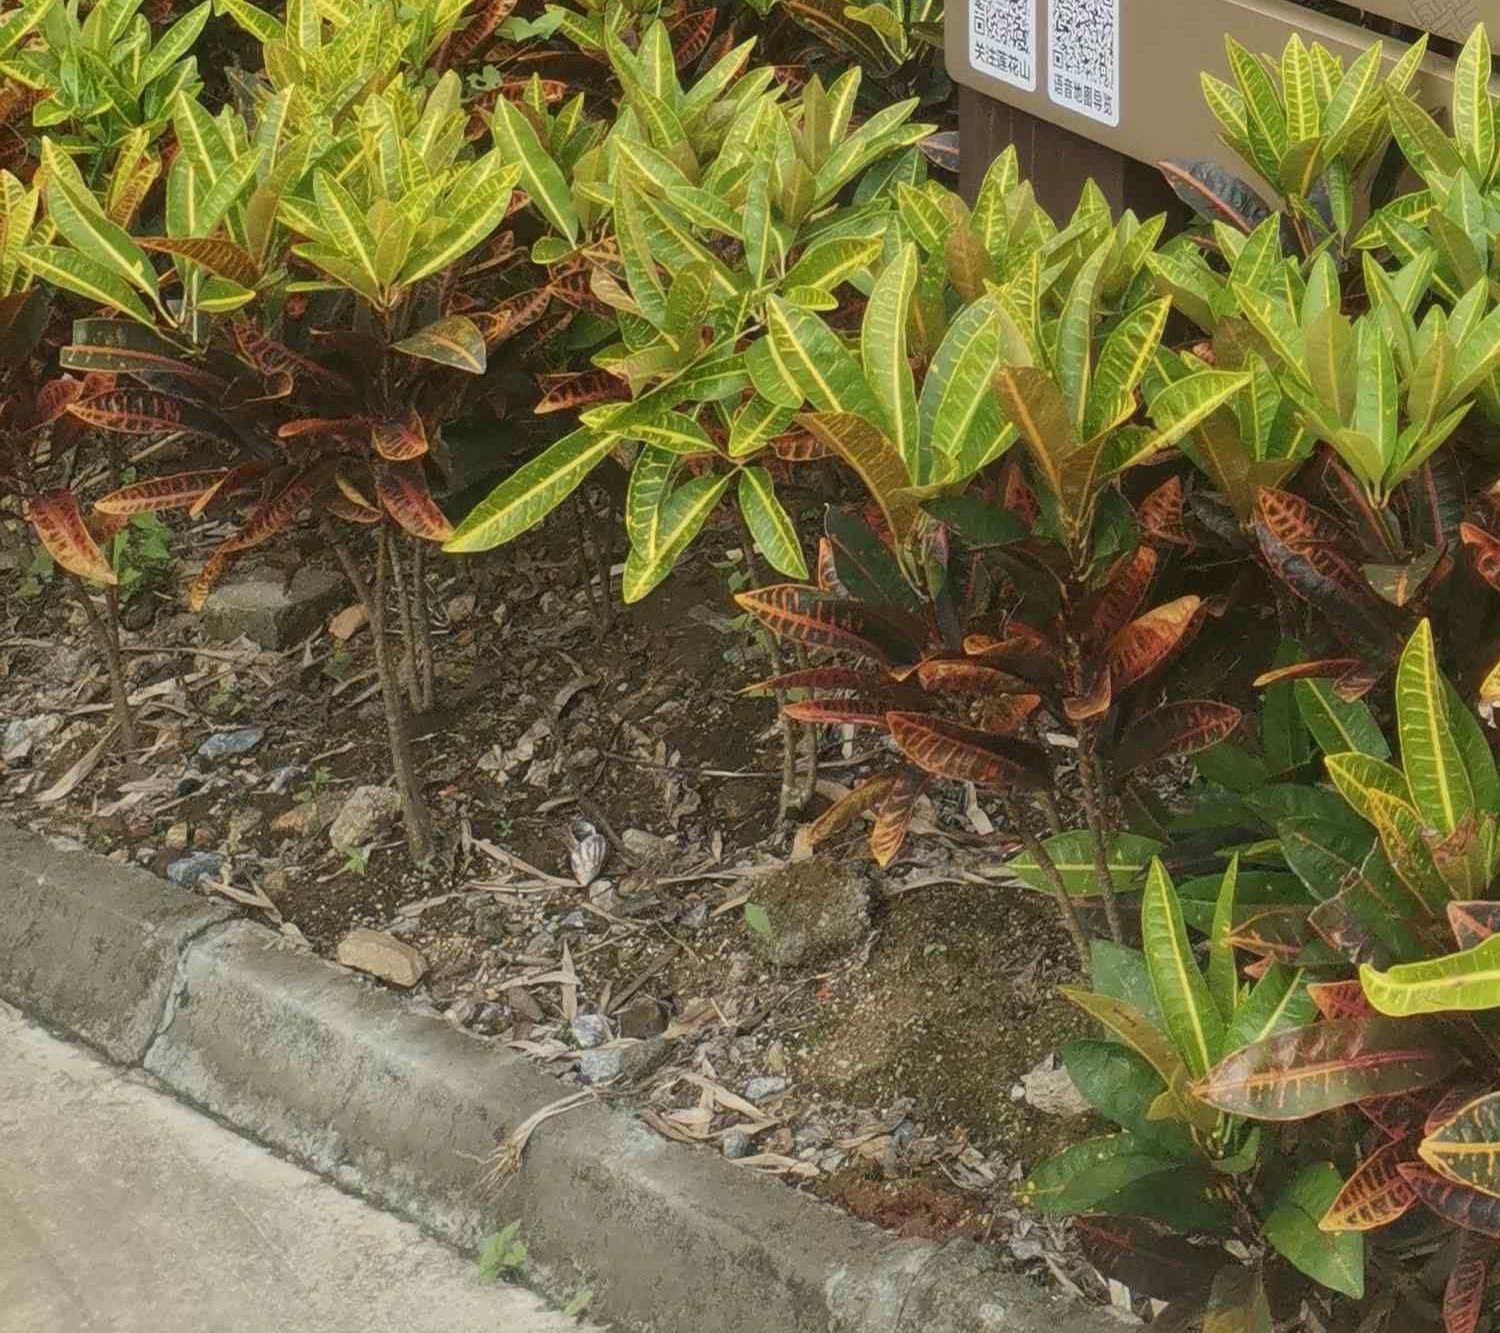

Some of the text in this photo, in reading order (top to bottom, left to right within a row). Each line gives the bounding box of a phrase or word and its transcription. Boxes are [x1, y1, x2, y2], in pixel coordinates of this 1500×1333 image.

[974, 41, 1031, 81] 关注莲花山
